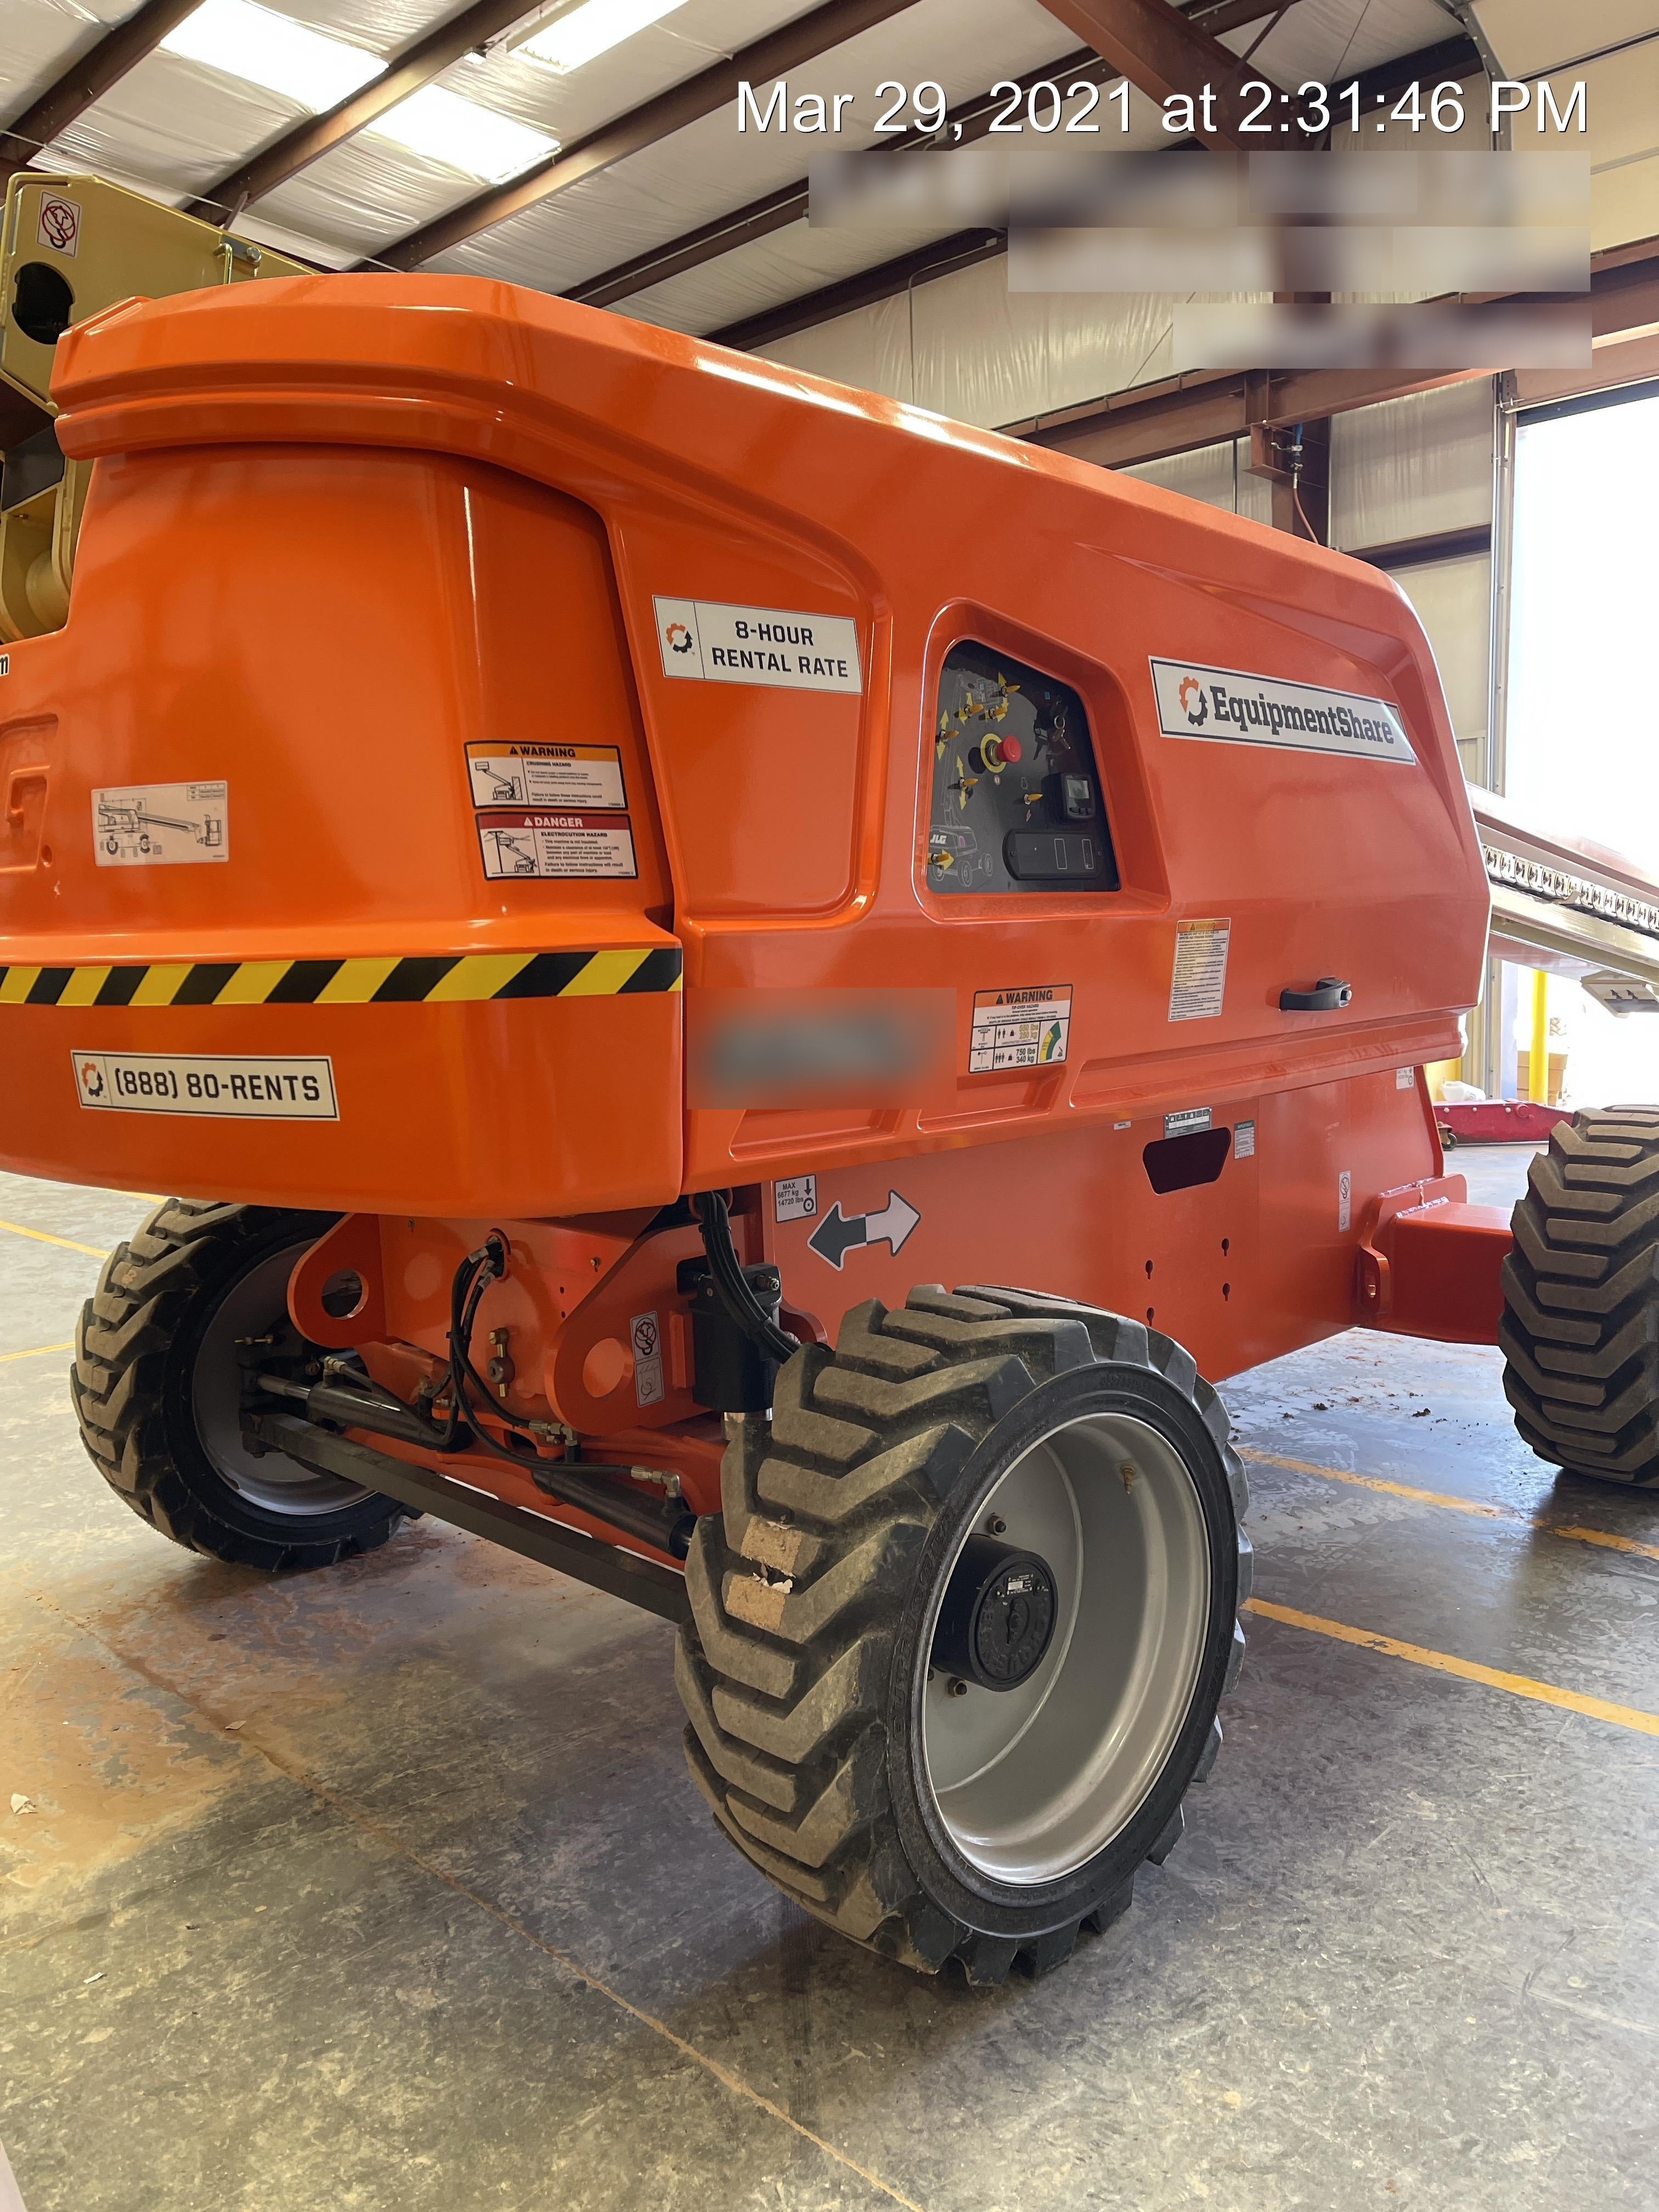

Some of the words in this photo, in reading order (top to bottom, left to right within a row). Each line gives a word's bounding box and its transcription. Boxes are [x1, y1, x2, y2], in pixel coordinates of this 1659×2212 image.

[735, 620, 814, 646] 8-HOUR
[712, 647, 792, 673] RENTAL
[798, 656, 848, 678] RATE
[1209, 685, 1395, 744] EquipmentShare
[520, 746, 576, 758] WARNING
[534, 817, 583, 827] DANGER
[930, 833, 947, 845] JLG
[1006, 990, 1053, 1003] WARNING
[1016, 1048, 1026, 1056] 750
[1028, 1055, 1034, 1063] kg
[115, 1067, 178, 1099] (888)
[186, 1073, 320, 1102] 80-RENTS
[782, 1182, 795, 1190] MAX
[777, 1190, 791, 1198] 6677
[778, 1198, 794, 1206] 14720
